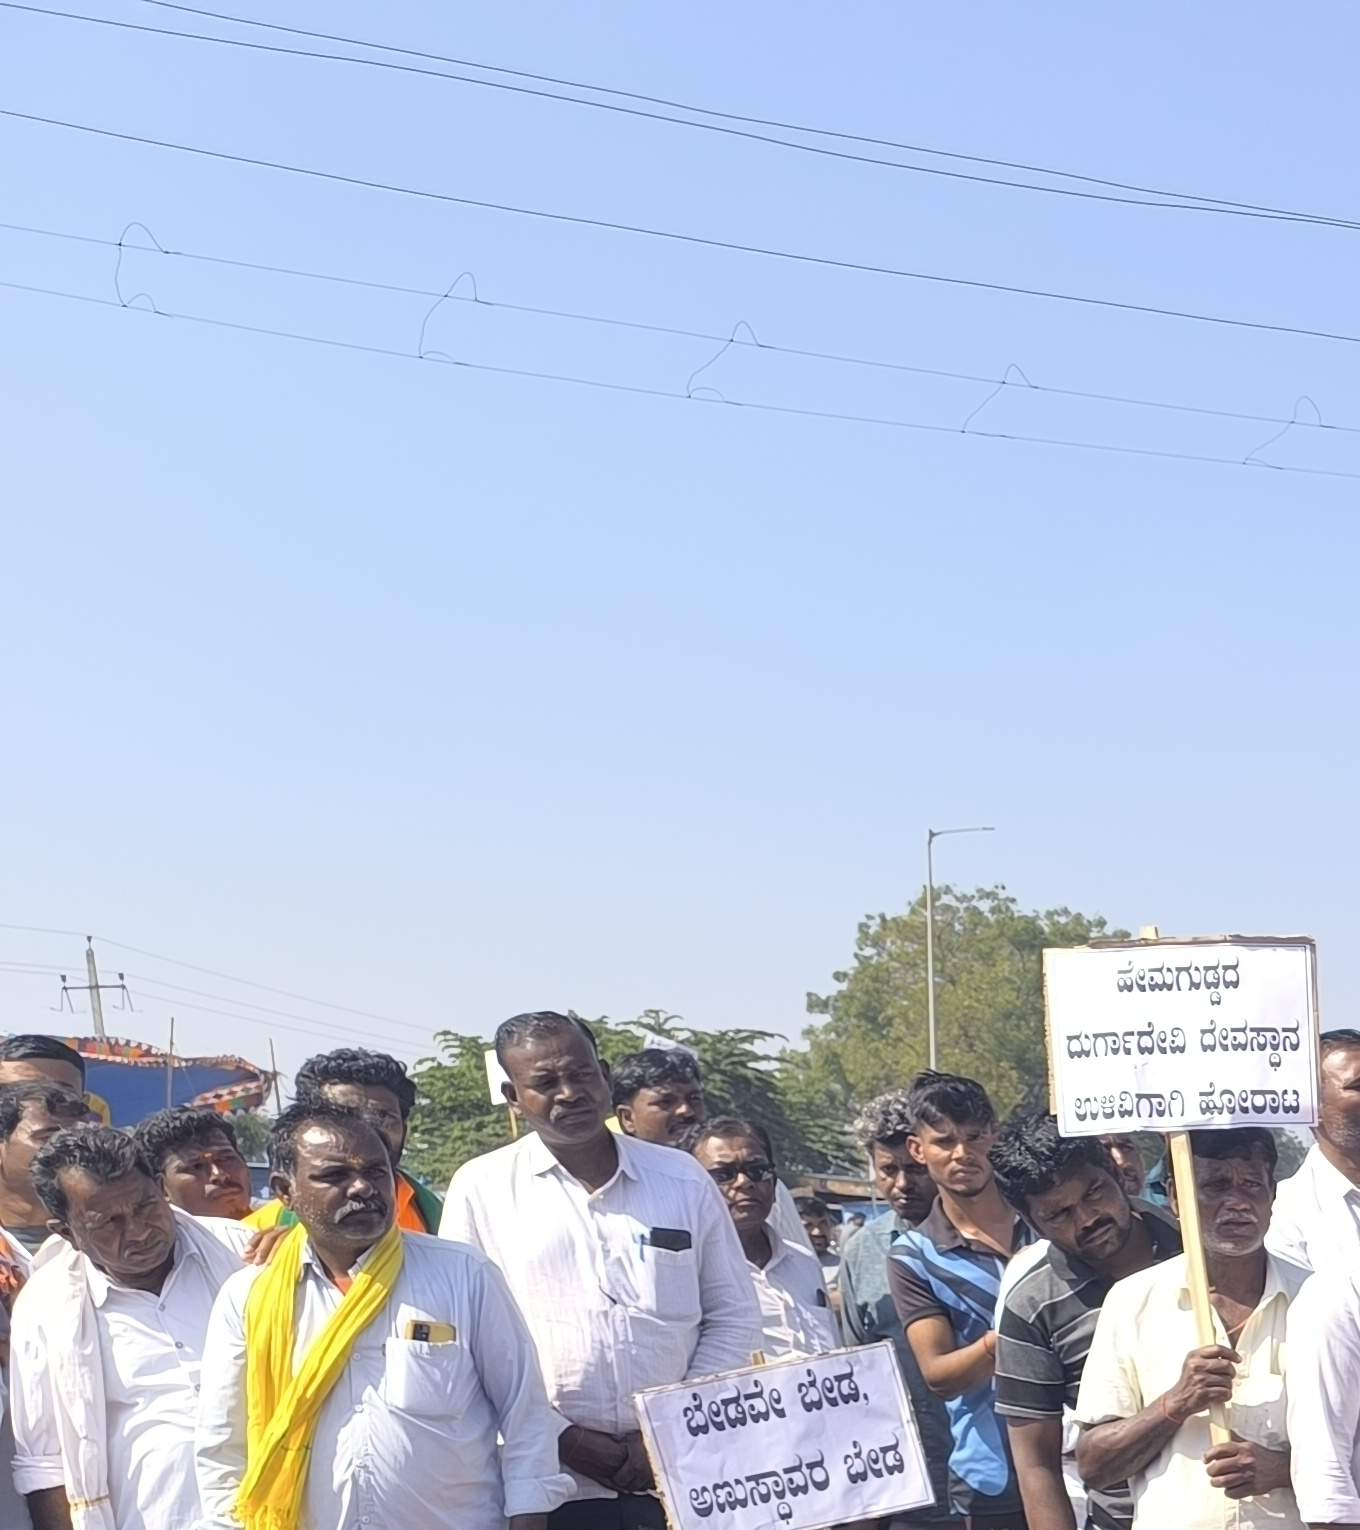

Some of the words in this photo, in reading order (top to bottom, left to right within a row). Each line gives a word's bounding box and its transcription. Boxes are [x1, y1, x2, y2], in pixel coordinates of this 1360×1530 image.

[1116, 955, 1240, 1006] ಹೇಮಗುಡ್ಡದ
[1066, 1021, 1187, 1060] ದುರ್ಗಾದೇವಿ
[1199, 1018, 1300, 1072] ದೇವಸ್ಥಾನ
[1074, 1089, 1185, 1122] ಉಳಿವಿಗಾಗಿ
[1199, 1082, 1300, 1116] ಹೋರಾಟ
[682, 1379, 787, 1438] ಬೇಡವೇ
[797, 1361, 870, 1413] ಬೇಡ,
[689, 1448, 830, 1525] ಅಣುಸ್ಥಾವರ
[843, 1431, 905, 1485] ಬೇಡ
